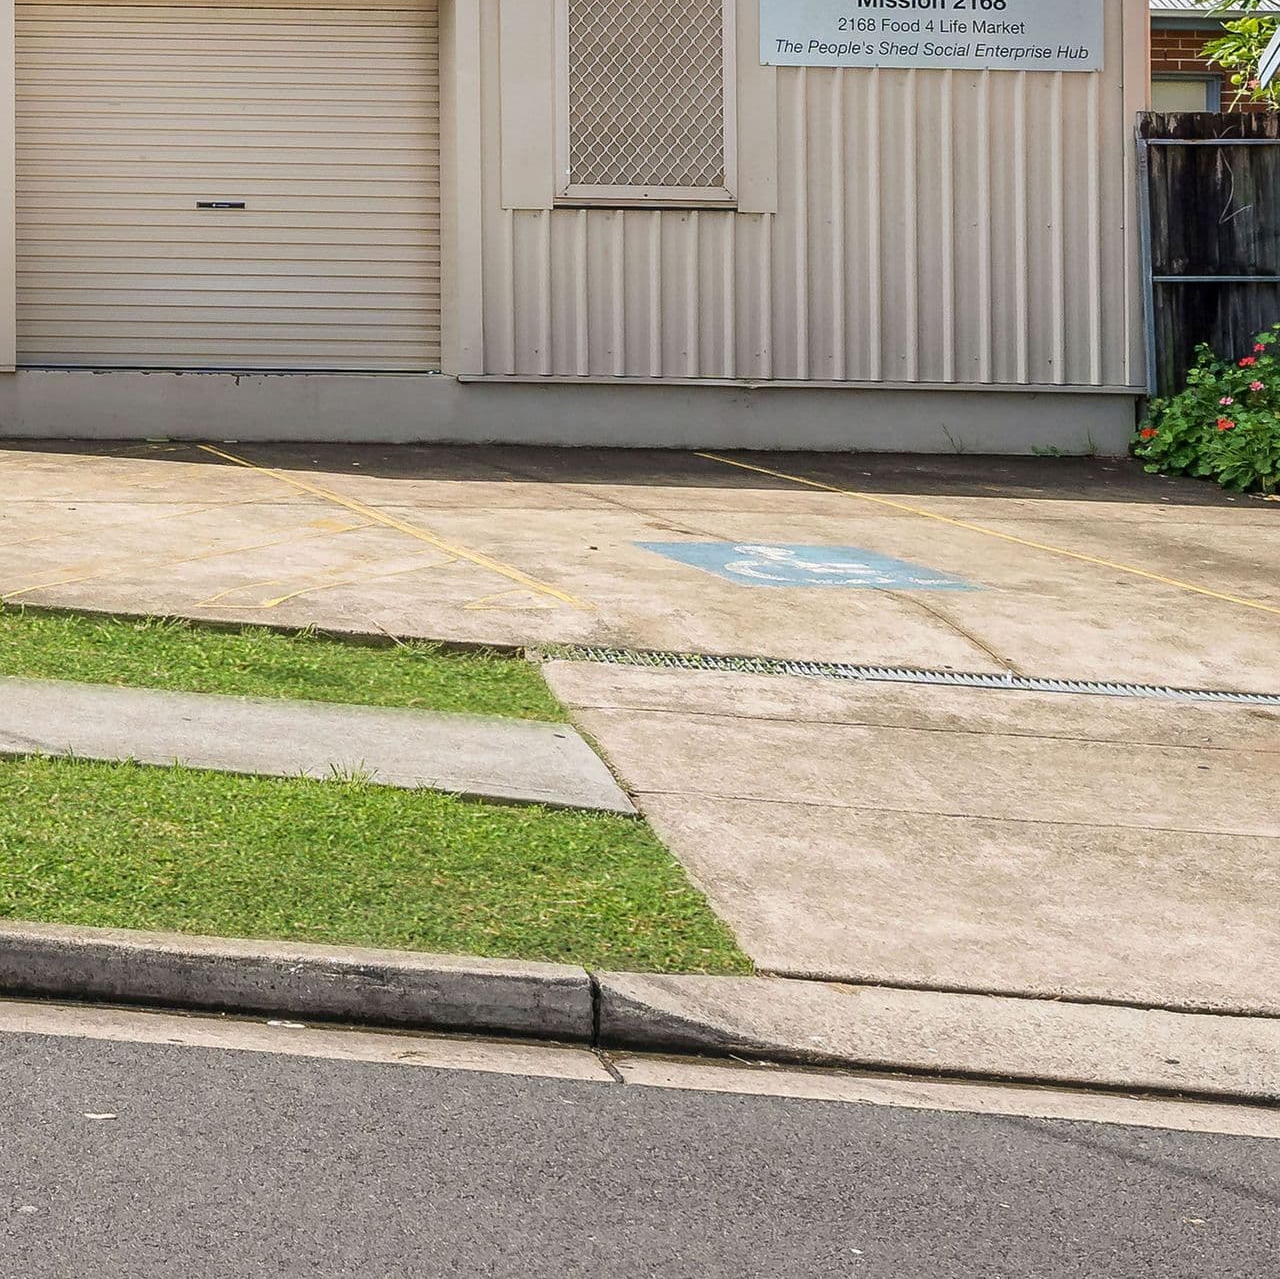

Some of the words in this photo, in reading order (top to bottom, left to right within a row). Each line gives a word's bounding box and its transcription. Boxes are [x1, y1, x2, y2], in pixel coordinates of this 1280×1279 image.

[838, 17, 876, 32] 2168
[881, 18, 920, 33] Food
[925, 20, 934, 33] 4
[940, 19, 967, 33] Life
[972, 20, 1026, 35] Market
[775, 39, 803, 54] The
[807, 40, 874, 57] People's
[878, 41, 919, 56] Shed
[923, 42, 970, 57] Social
[974, 43, 1052, 60] Enterprise
[1056, 45, 1089, 60] Hub
